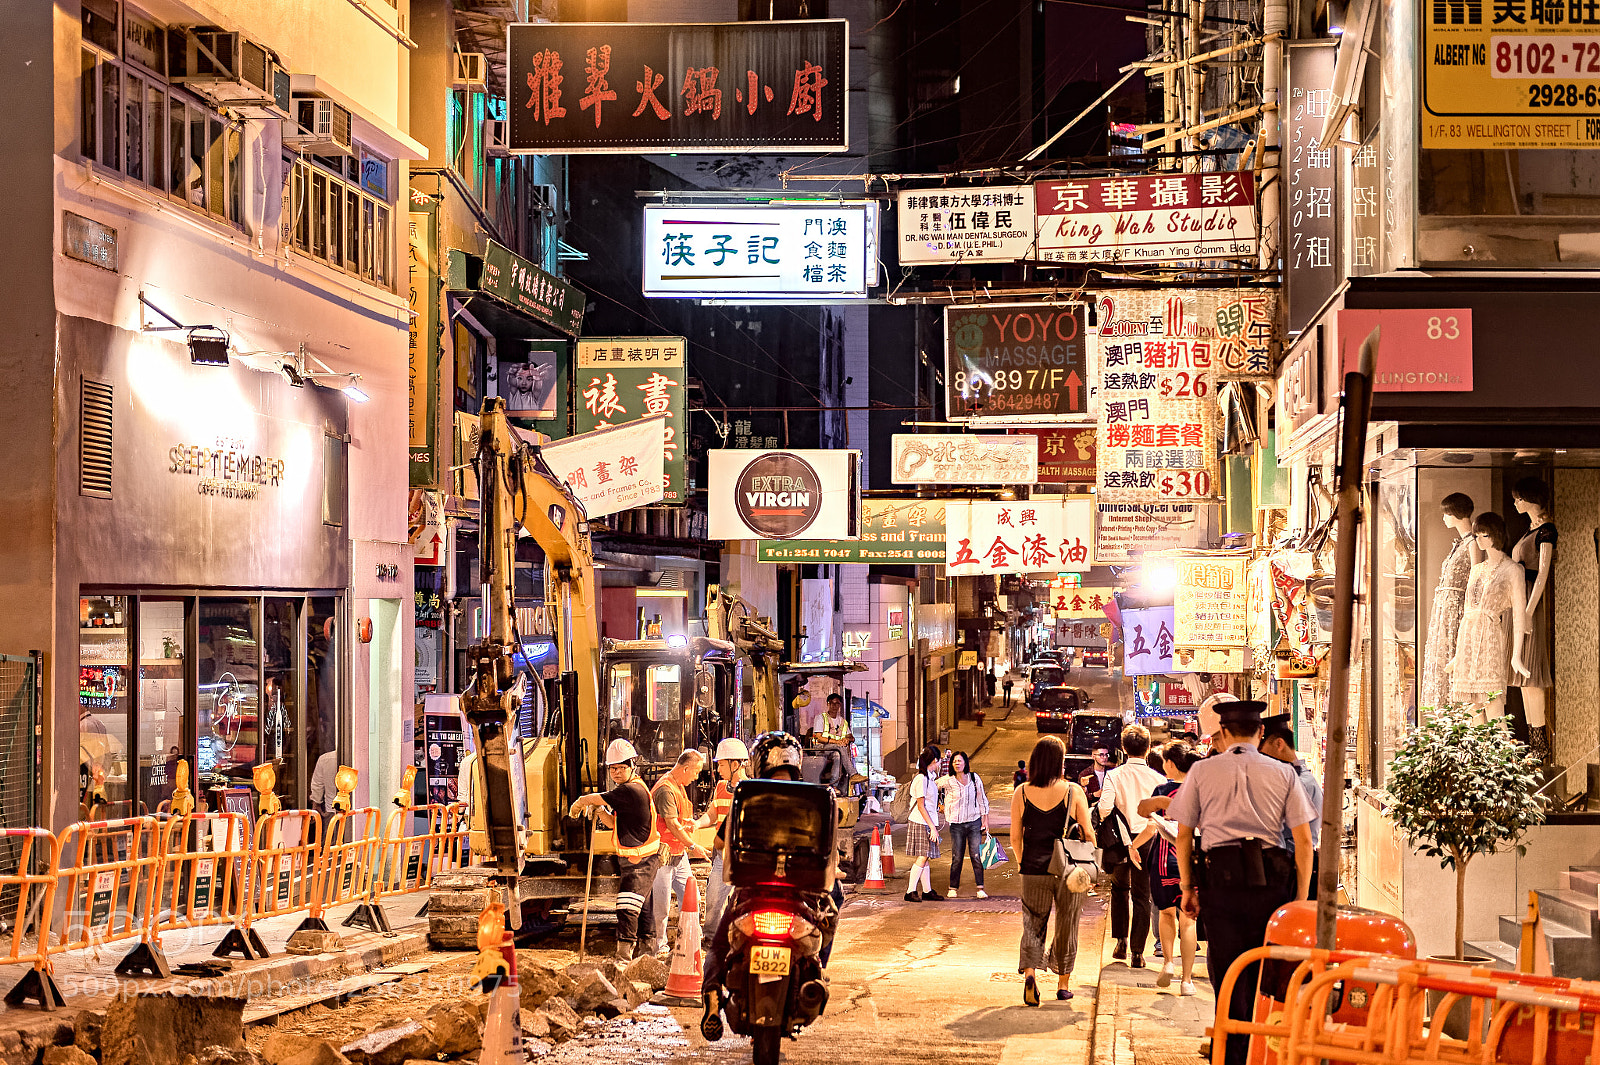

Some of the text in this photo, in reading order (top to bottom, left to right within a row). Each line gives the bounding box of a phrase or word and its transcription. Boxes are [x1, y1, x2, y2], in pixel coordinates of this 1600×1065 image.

[1434, 44, 1470, 66] ALBERT
[1472, 43, 1486, 66] NG
[1529, 84, 1600, 107] 2928-6
[1450, 125, 1462, 138] 83
[1467, 124, 1530, 138] WELLINGTON
[1535, 124, 1571, 138] STREET
[907, 192, 1025, 210] 菲律賓東方大學牙科博士
[1050, 174, 1239, 212] 京華攝影
[948, 210, 1013, 231] 伍偉民
[1055, 209, 1238, 244] King Wah Studio
[905, 234, 918, 242] DR.
[930, 233, 945, 241] WAI
[946, 232, 964, 241] MAN
[964, 231, 992, 240] DENTAL
[993, 230, 1028, 239] SURGEON
[661, 232, 781, 267] 筷子記
[1134, 247, 1165, 258] Khuan
[1169, 245, 1190, 258] Ying
[1229, 243, 1251, 255] Bldg
[992, 312, 1078, 343] YOYO
[1426, 316, 1460, 340] 83
[985, 344, 1078, 367] MASSAGE
[1104, 372, 1208, 398] 送熱飲 $26
[1374, 372, 1449, 384] LLINGTON
[1105, 398, 1150, 424] 澳門
[1106, 423, 1204, 448] 撈麵套餐
[168, 443, 285, 487] SEPTEMBER
[1038, 466, 1097, 477] EALTH MASSAGE
[607, 483, 637, 496] Frames
[617, 484, 661, 503] Since 1983
[751, 475, 806, 492] EXTRA
[1103, 470, 1210, 496] 送熱飲 $30
[745, 491, 810, 507] VIRGIN
[997, 507, 1038, 528] 成興
[881, 530, 905, 542] and
[823, 549, 851, 558] 7047
[950, 533, 1088, 569] 五金漆油
[1056, 594, 1112, 611] 五金漆
[753, 960, 787, 973] 3822
